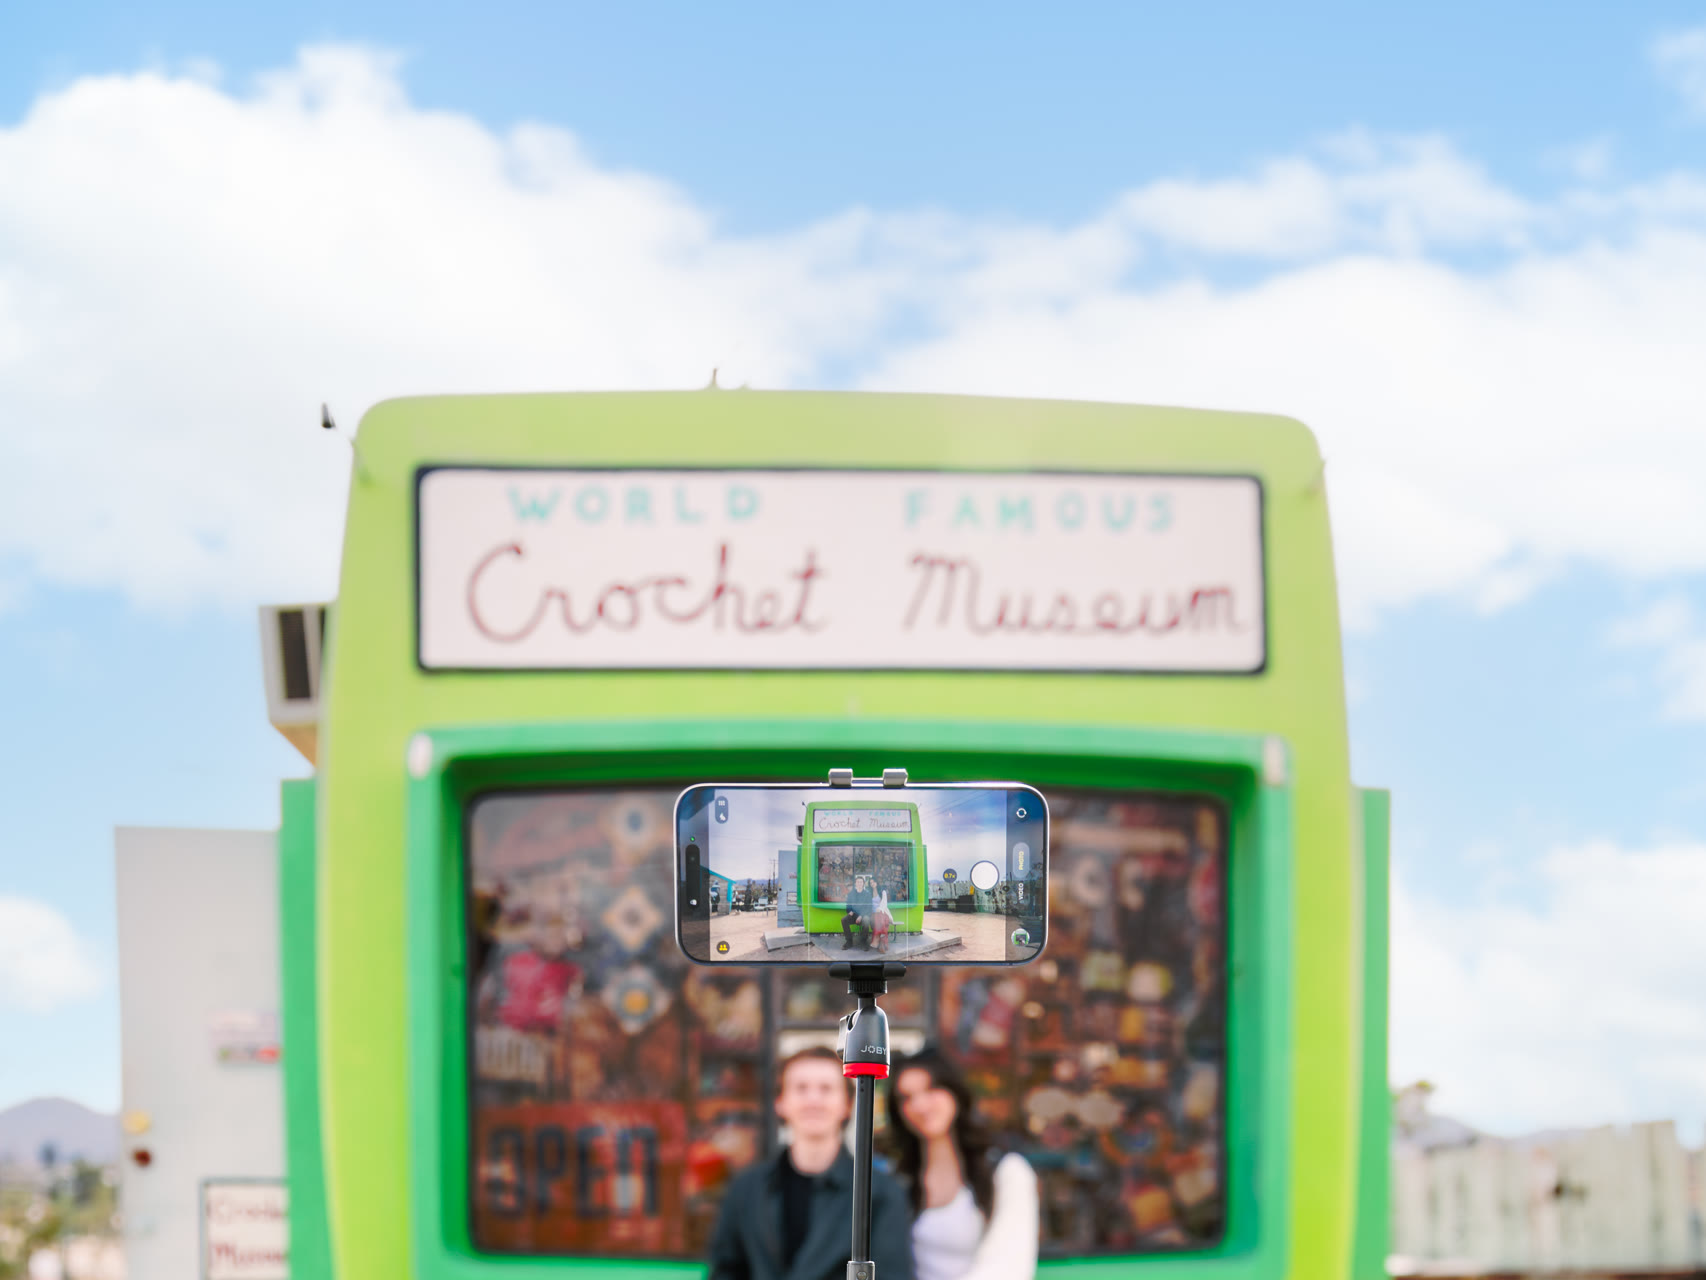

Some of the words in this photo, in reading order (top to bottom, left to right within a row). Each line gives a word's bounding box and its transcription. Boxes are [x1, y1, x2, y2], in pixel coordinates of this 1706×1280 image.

[507, 485, 762, 523] WORLD
[903, 489, 1174, 532] FAMOUS
[466, 538, 830, 642] Crochet
[901, 549, 1249, 638] Museum
[819, 817, 860, 830] Crochet
[860, 1044, 888, 1056] JOBY
